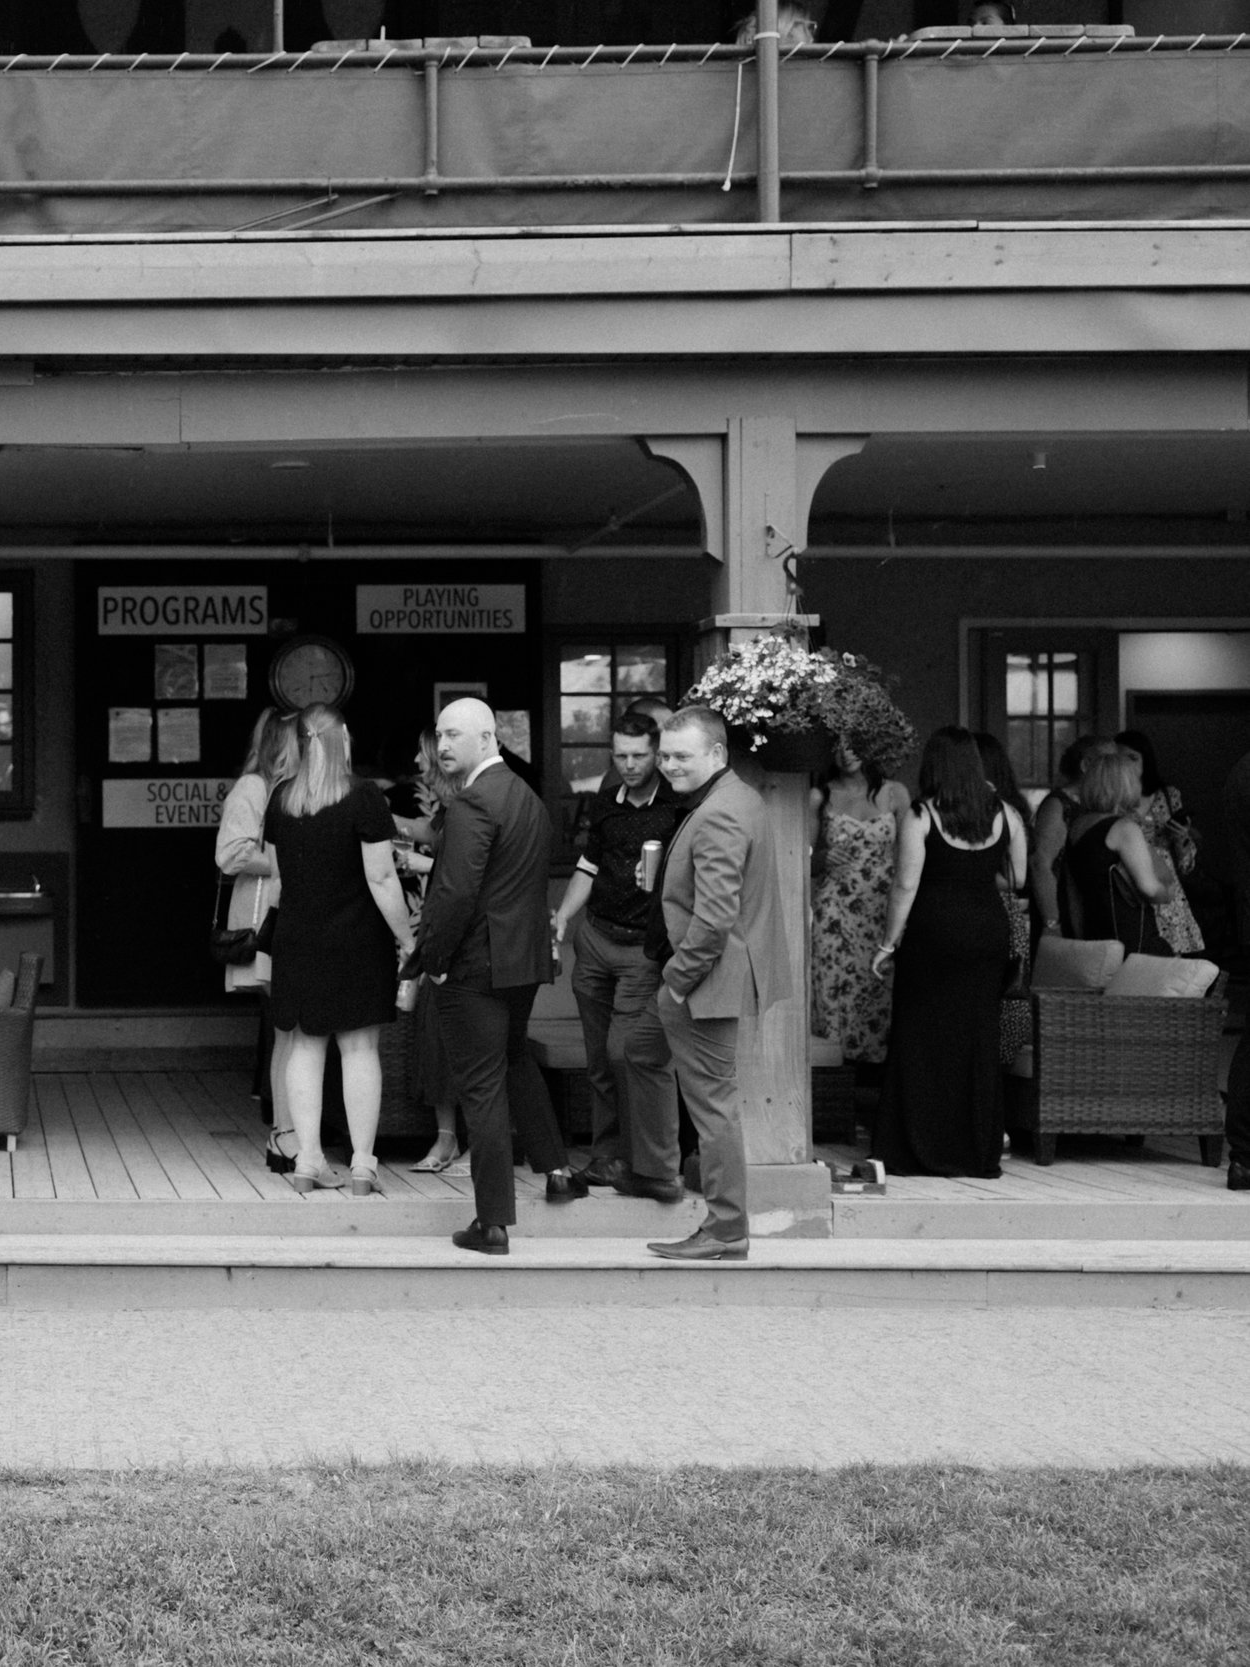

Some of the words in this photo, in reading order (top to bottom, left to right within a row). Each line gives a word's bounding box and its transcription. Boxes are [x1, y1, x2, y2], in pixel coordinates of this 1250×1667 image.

[403, 587, 479, 608] PLAYING
[103, 595, 264, 626] PROGRAMS
[369, 609, 513, 629] OPPORTUNITIES
[146, 782, 211, 802] SOCIAL
[216, 782, 229, 802] &
[155, 804, 221, 824] EVENTS
